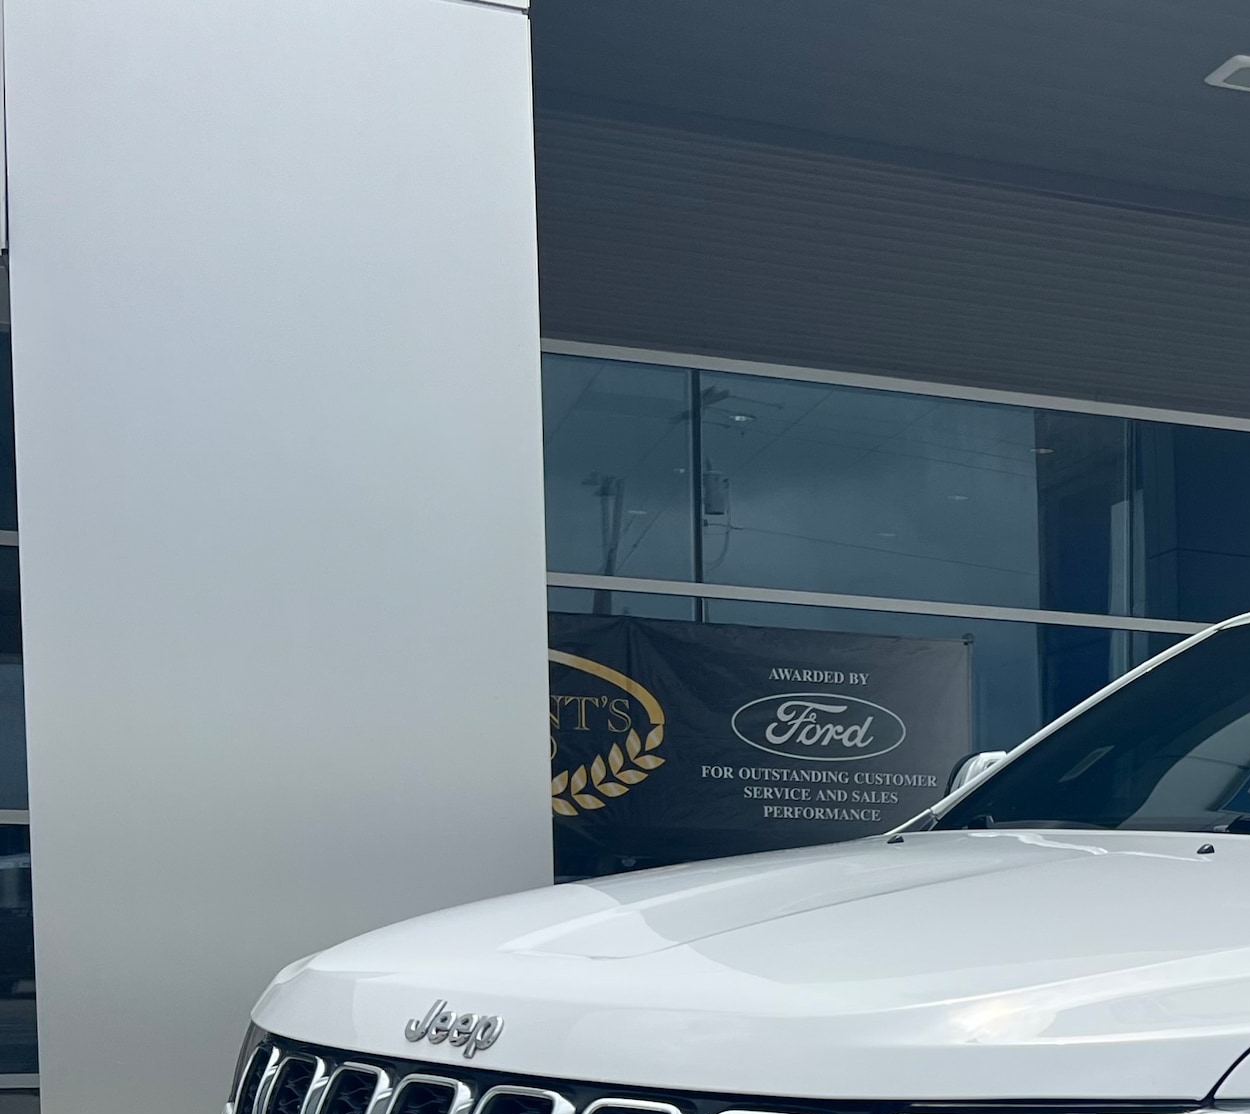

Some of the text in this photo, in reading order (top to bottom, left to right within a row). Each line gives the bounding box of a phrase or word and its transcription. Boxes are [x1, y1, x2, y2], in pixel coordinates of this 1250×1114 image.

[769, 667, 870, 686] AWARDED BY
[765, 700, 874, 748] Ford
[701, 765, 938, 788] FOR OUTSTANDING CUSTOMER
[743, 786, 899, 804] SERVICE AND SALES
[763, 805, 881, 822] PERFORMANCE
[405, 999, 504, 1059] Jeep
